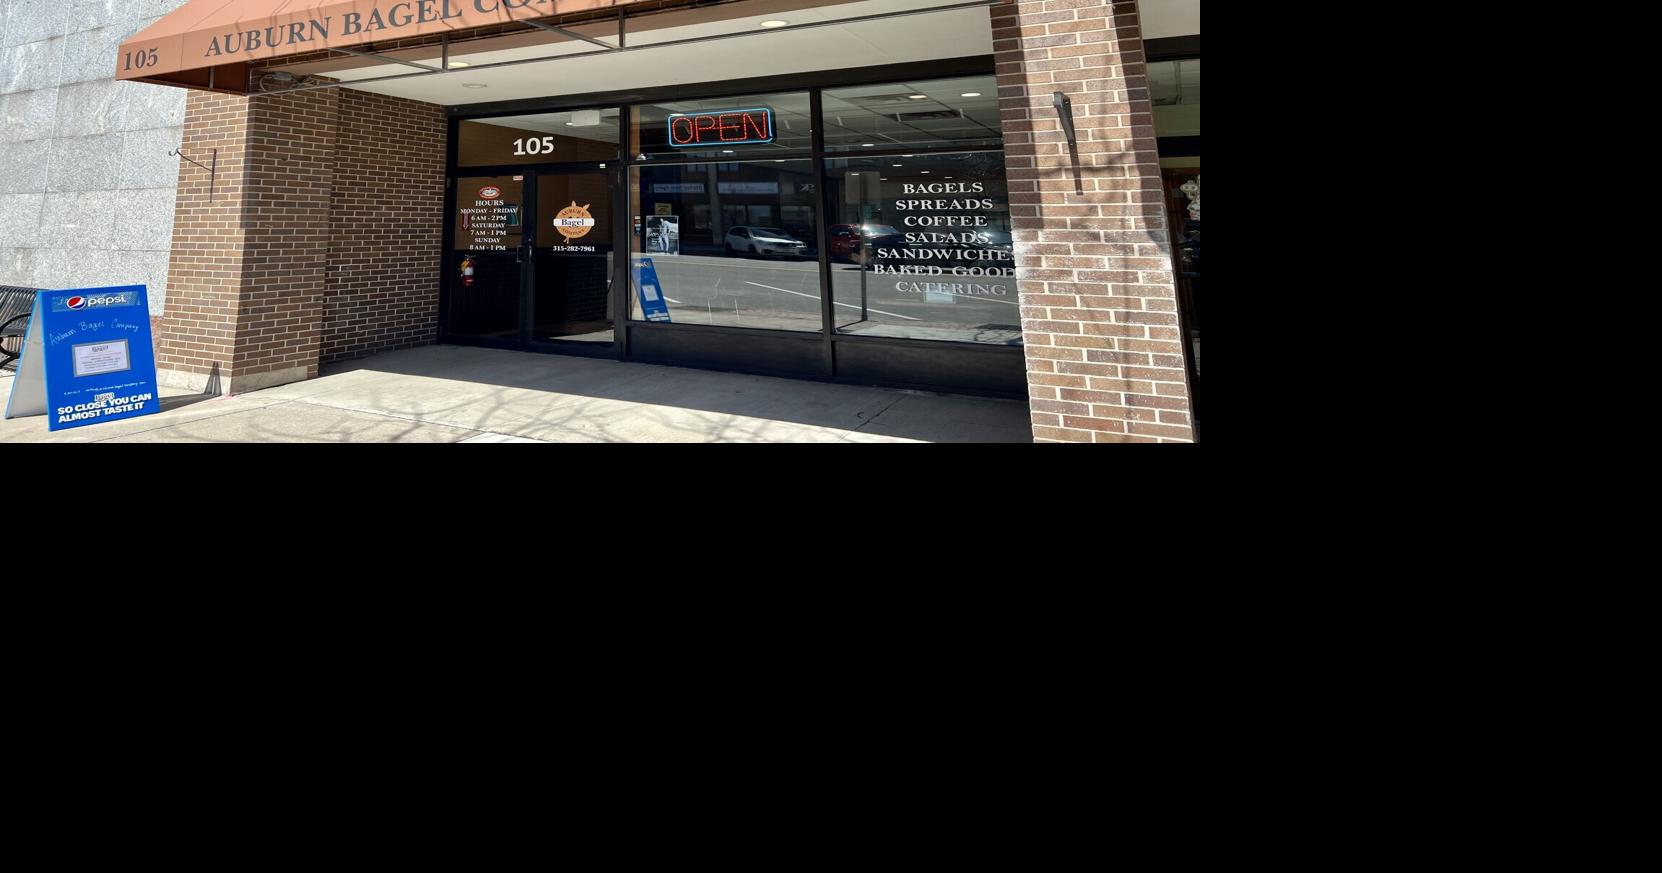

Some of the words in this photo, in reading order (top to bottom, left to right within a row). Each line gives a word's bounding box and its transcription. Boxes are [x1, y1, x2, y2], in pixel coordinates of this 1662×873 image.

[204, 16, 331, 57] AUBURN
[341, 0, 463, 36] BAGEL
[123, 47, 159, 71] 105
[672, 112, 767, 144] OPEN
[512, 136, 554, 156] 105
[903, 181, 984, 195] BAGELS
[475, 199, 504, 207] HOURS
[895, 198, 994, 211] SPREADS
[561, 218, 585, 227] Bagel
[904, 215, 988, 227] COFFEE
[905, 231, 989, 244] SALADS
[873, 264, 943, 276] BAKED
[895, 281, 1007, 296] CATERING
[87, 294, 127, 307] pepsi
[79, 320, 105, 331] Bagel
[57, 406, 74, 415] SO
[74, 399, 108, 412] CLOSE
[108, 396, 130, 406] YOU
[130, 392, 152, 401] CAN
[58, 408, 102, 423] ALMOST
[102, 403, 134, 415] TASTE
[134, 401, 145, 410] IT
